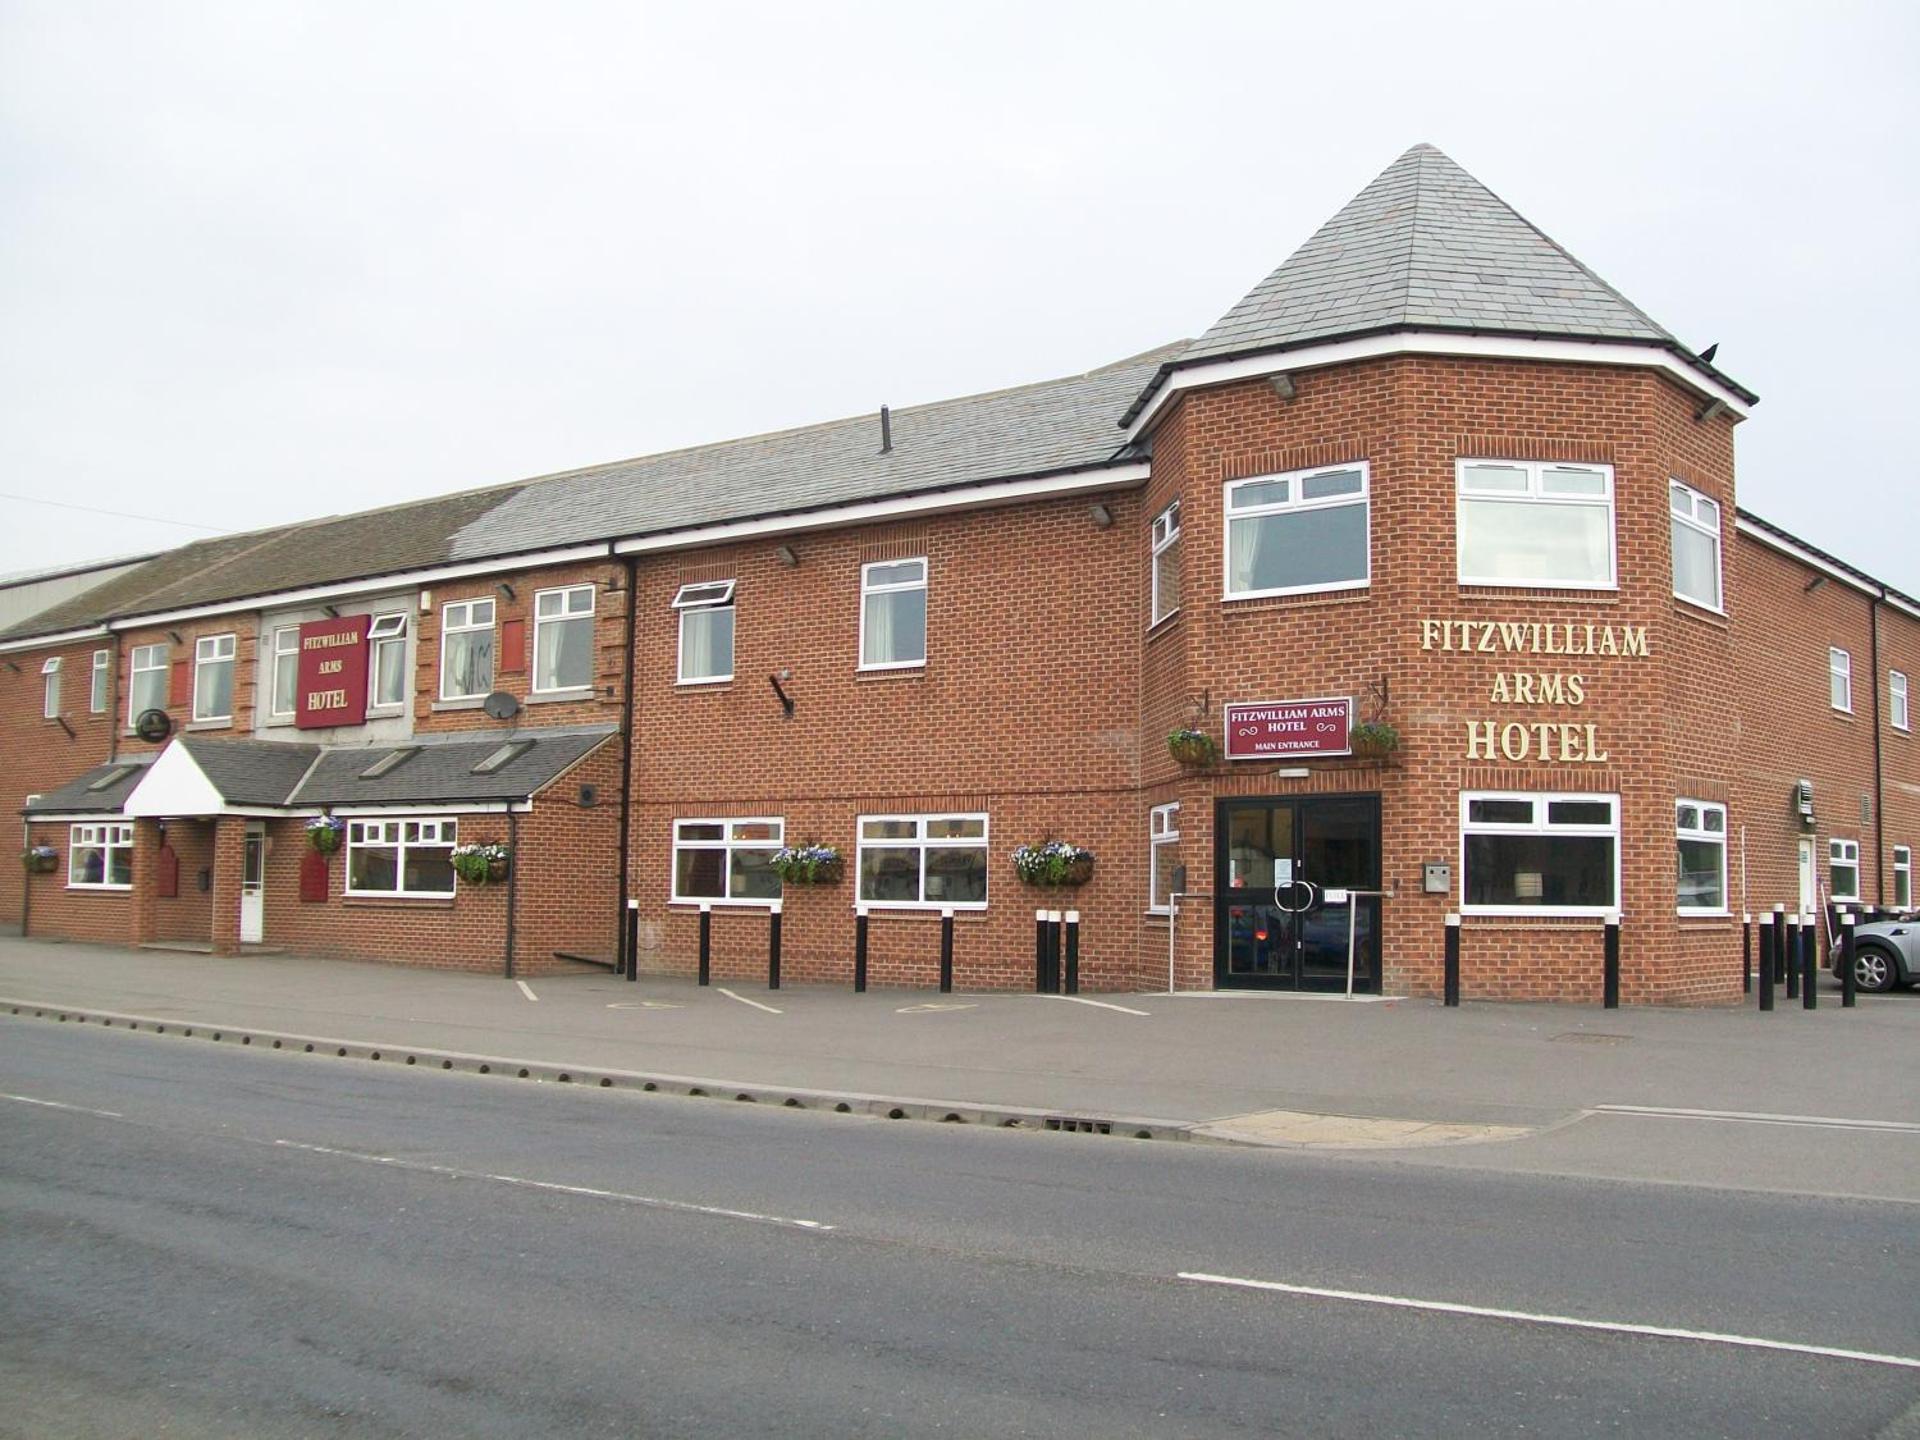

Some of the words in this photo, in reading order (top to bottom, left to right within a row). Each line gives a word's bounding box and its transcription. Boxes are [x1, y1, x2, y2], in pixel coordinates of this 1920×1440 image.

[303, 631, 358, 650] FITZWILLIAM
[1420, 619, 1650, 657] FITZWILLIAM
[318, 660, 343, 674] ARMS
[1490, 672, 1585, 705] ARMS
[307, 689, 348, 711] HOTEL
[1231, 708, 1307, 722] FITZWILLIAM
[1310, 706, 1345, 718] ARMS
[1268, 721, 1307, 733] HOTEL
[1255, 742, 1276, 750] MAIN
[1278, 740, 1320, 750] ENTRANCE
[1467, 721, 1608, 762] HOTEL
